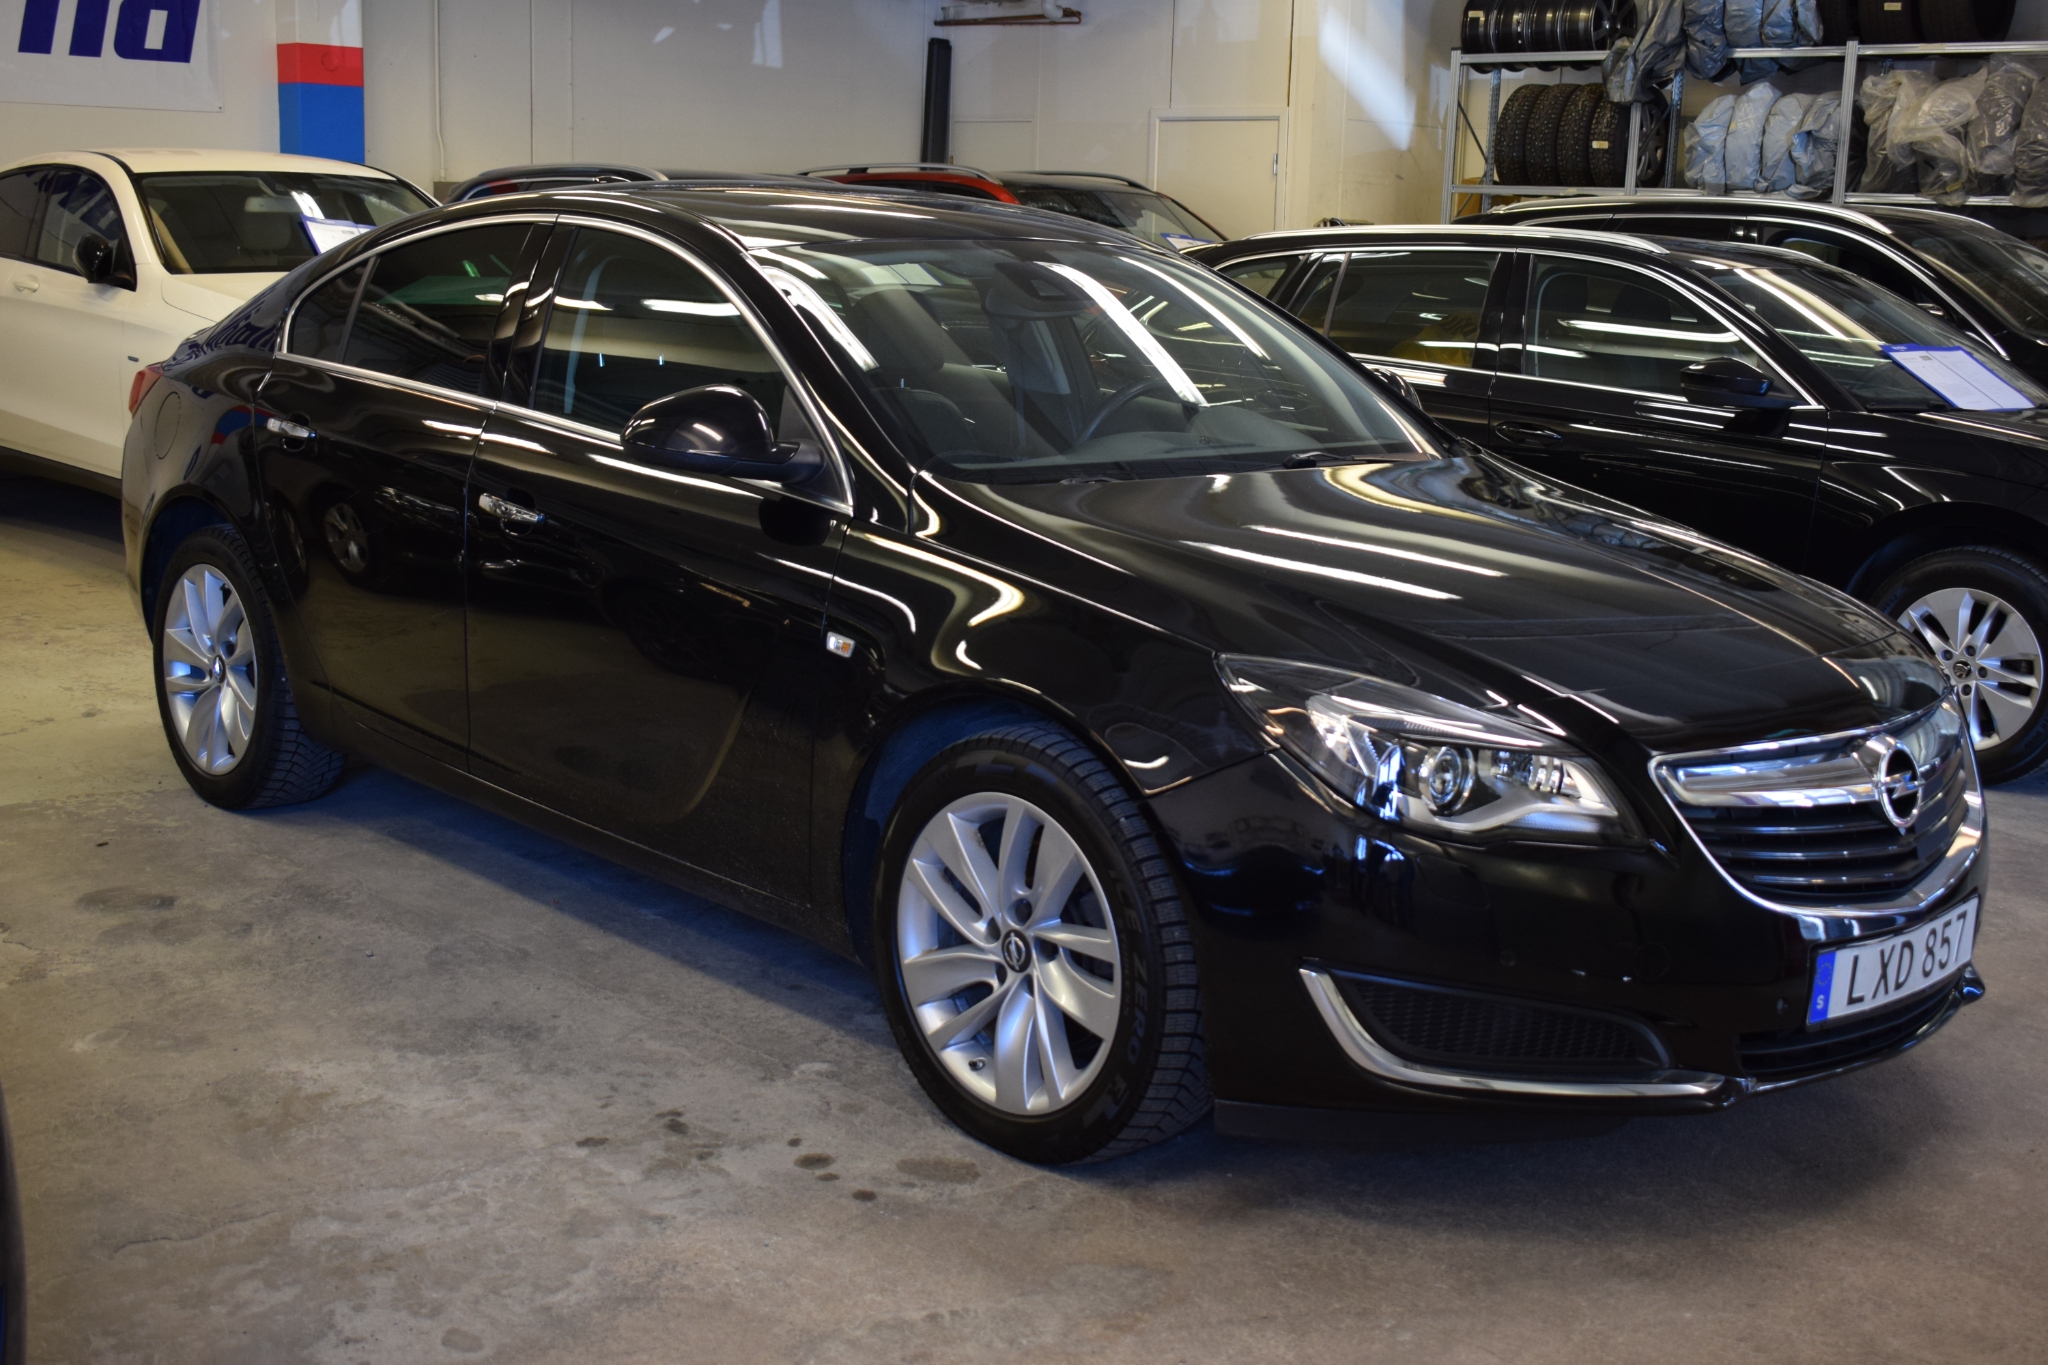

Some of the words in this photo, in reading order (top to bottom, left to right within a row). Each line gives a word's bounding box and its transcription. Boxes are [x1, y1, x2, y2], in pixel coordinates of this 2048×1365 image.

[1107, 868, 1143, 934] ICE
[1126, 950, 1149, 1065] ZERO
[1816, 994, 1825, 1009] S
[1846, 939, 1915, 1006] LXD
[1922, 908, 1968, 978] 857
